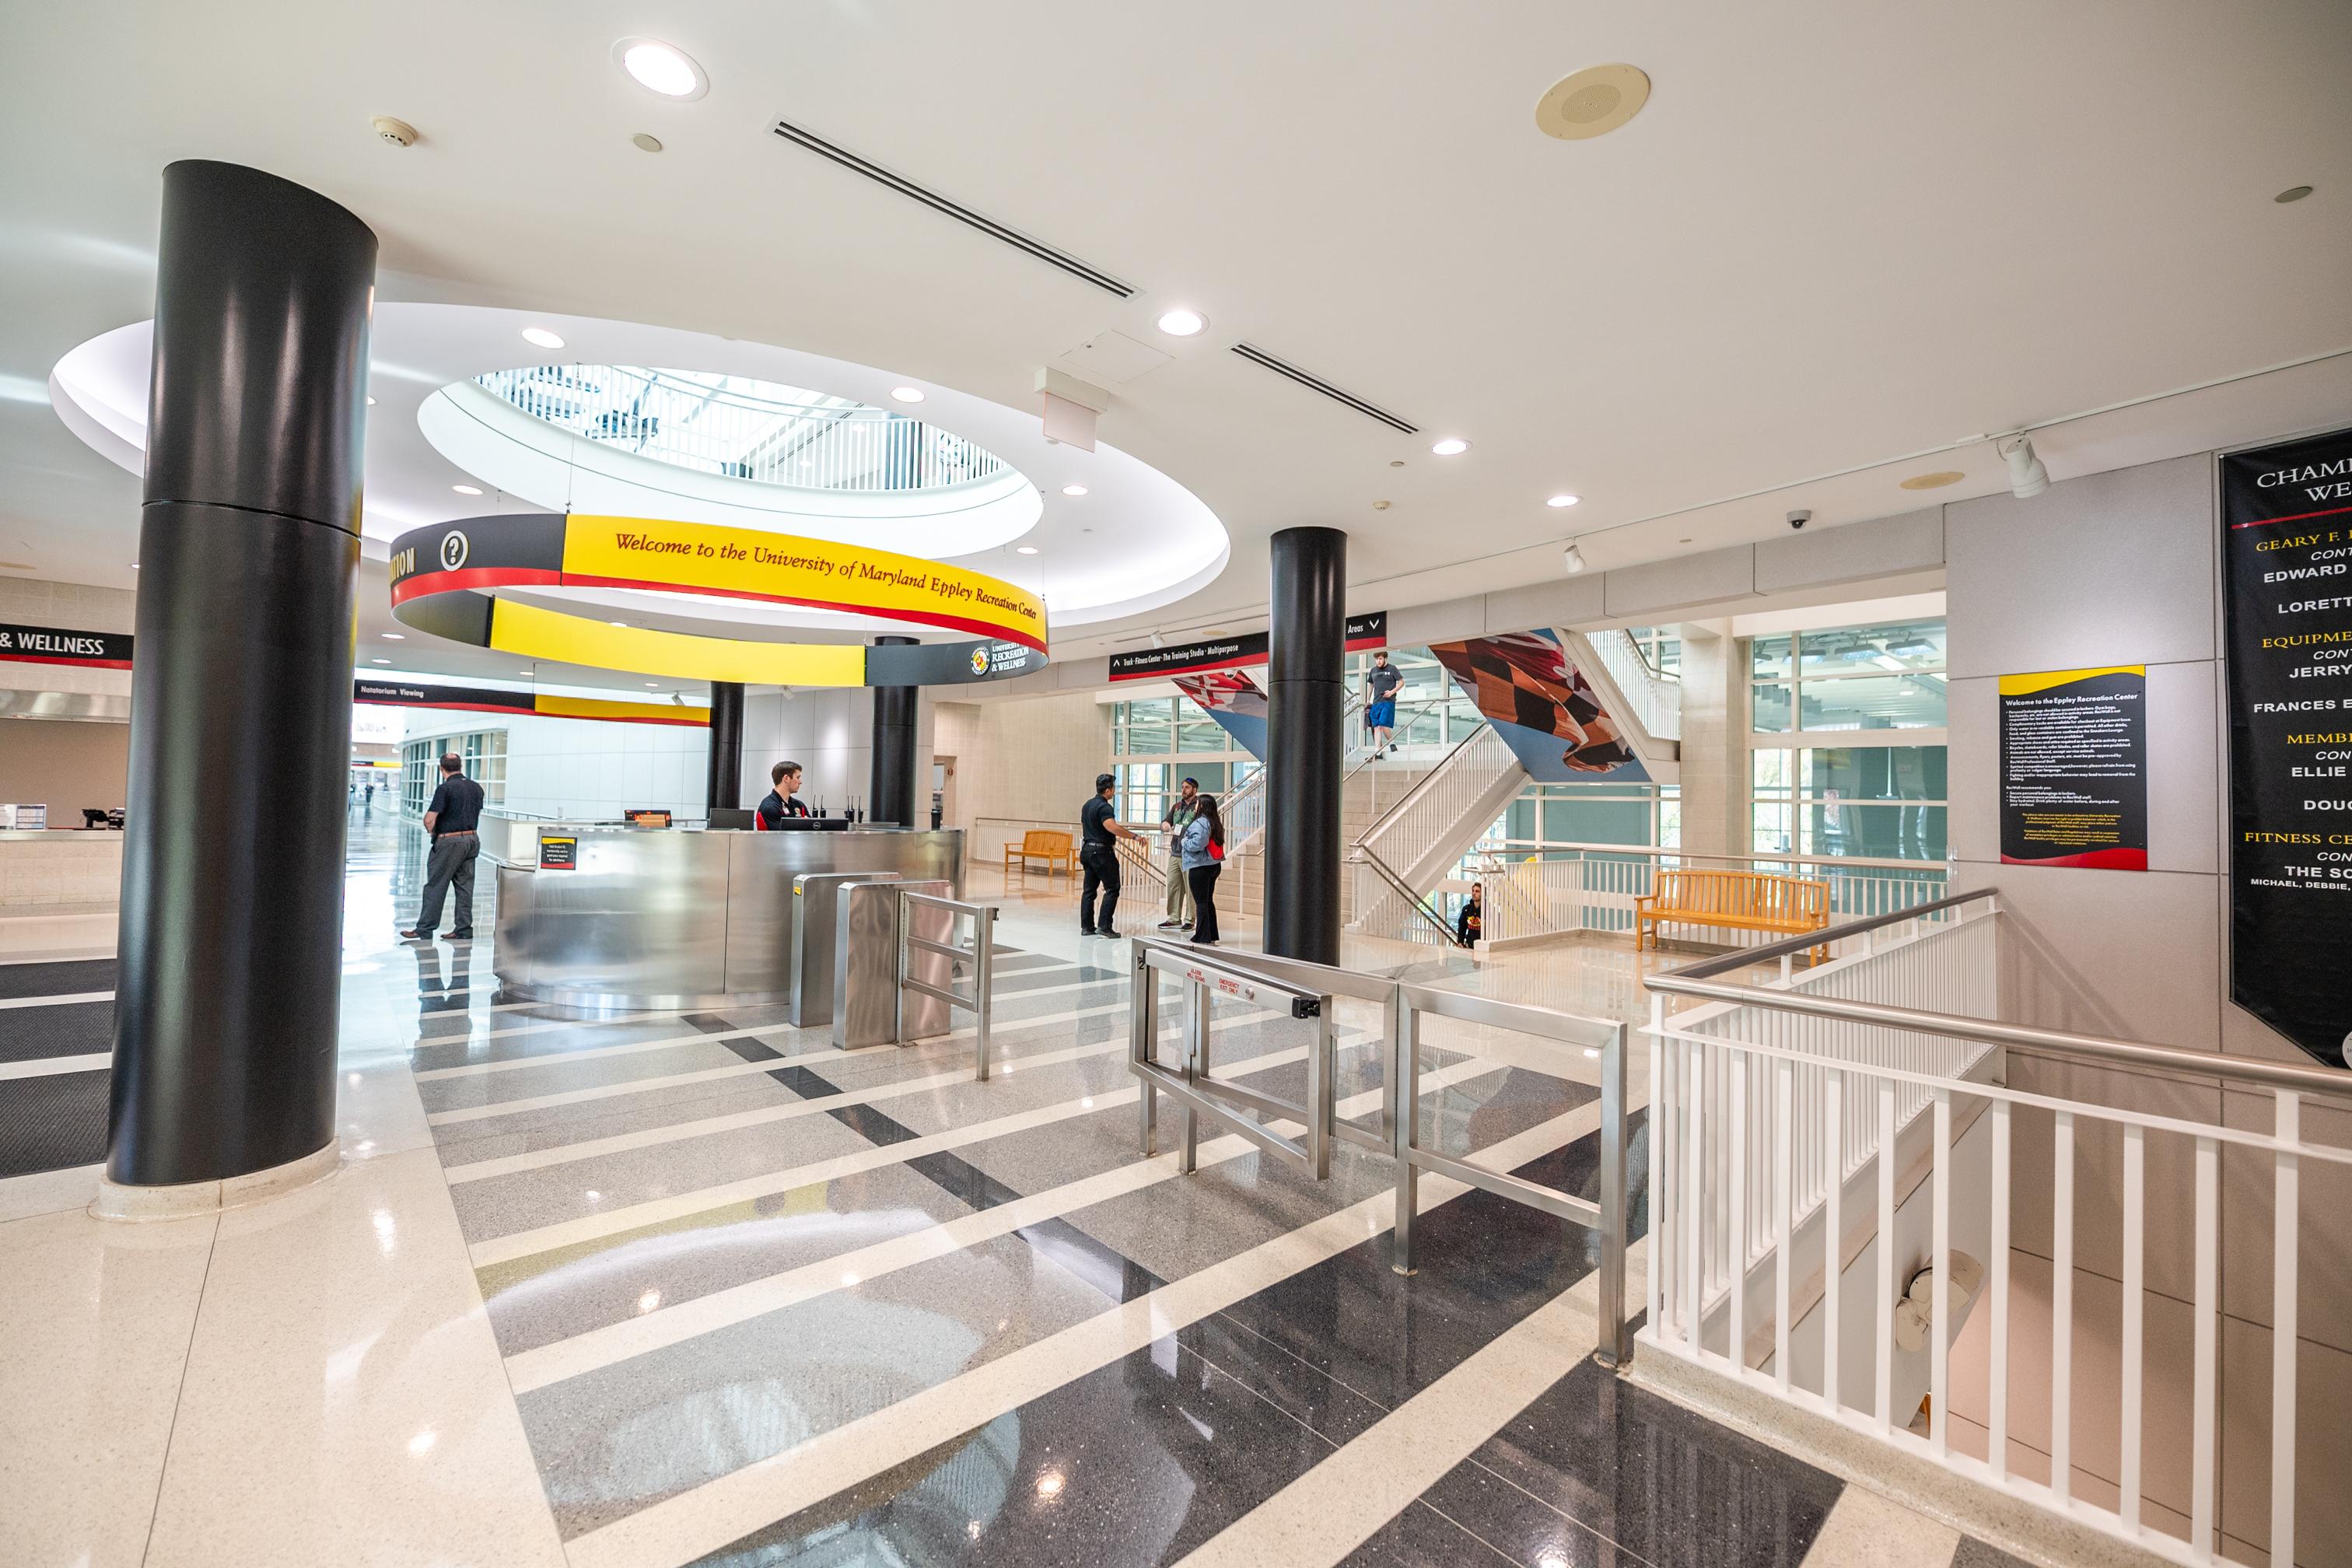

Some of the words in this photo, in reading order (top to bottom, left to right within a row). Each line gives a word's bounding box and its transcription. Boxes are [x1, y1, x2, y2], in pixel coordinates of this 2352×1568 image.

[2304, 481, 2352, 502] WE
[2256, 534, 2321, 551] GEARY
[2329, 532, 2340, 542] F.
[616, 534, 691, 555] Welcome
[697, 543, 714, 558] to
[720, 543, 747, 561] the
[754, 547, 835, 576] University
[839, 561, 858, 579] of
[859, 562, 926, 589] Maryland
[930, 577, 972, 601] Eppley
[975, 588, 1017, 612] Recreation
[1019, 602, 1037, 620] Center
[2264, 564, 2347, 583] EDWARD
[2278, 597, 2352, 614] LORETT
[0, 632, 12, 648] &
[18, 632, 104, 655] WELLNESS
[1135, 656, 1148, 665] Fitness
[1171, 652, 1189, 660] Training
[1190, 648, 1204, 657] Studio
[1207, 644, 1239, 655] Multipurpose
[1348, 625, 1363, 634] Areas
[2262, 631, 2352, 649] EQUIPME
[992, 646, 1029, 662] RECREATION
[992, 663, 998, 673] &
[998, 657, 1026, 672] WELLNESS
[2289, 664, 2352, 678] JERRY
[361, 685, 397, 695] Natatorium
[399, 688, 424, 698] Viewing
[2054, 697, 2077, 705] Eppley
[2254, 699, 2336, 713] FRANCES
[2315, 751, 2352, 760] CON
[2292, 766, 2347, 777] ELLIE
[2245, 832, 2321, 844] FITNESS
[2329, 835, 2352, 845] CE
[2317, 852, 2352, 862] CON
[2284, 866, 2322, 877] THE
[2251, 879, 2302, 888] MICHAEL,
[2305, 881, 2350, 891] DEBBIE,
[1139, 961, 1144, 970] 2
[1195, 975, 1206, 983] SOUND
[1219, 978, 1240, 989] EMERGENCY
